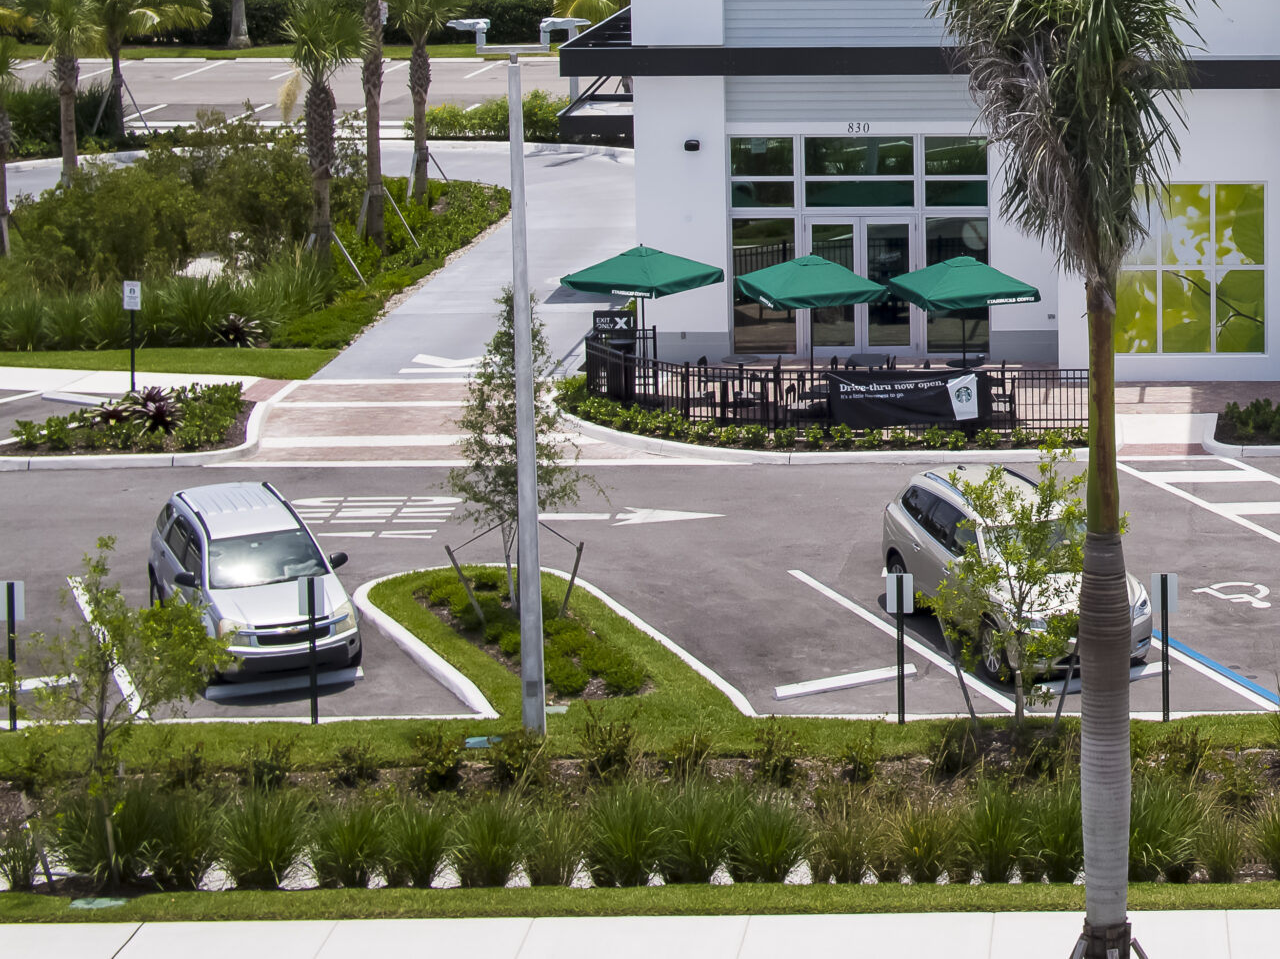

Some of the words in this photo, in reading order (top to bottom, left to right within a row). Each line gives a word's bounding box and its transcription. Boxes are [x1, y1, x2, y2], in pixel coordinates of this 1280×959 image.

[847, 122, 870, 133] 830
[839, 383, 892, 392] Drive-thru
[894, 382, 915, 390] now
[918, 380, 945, 390] open.
